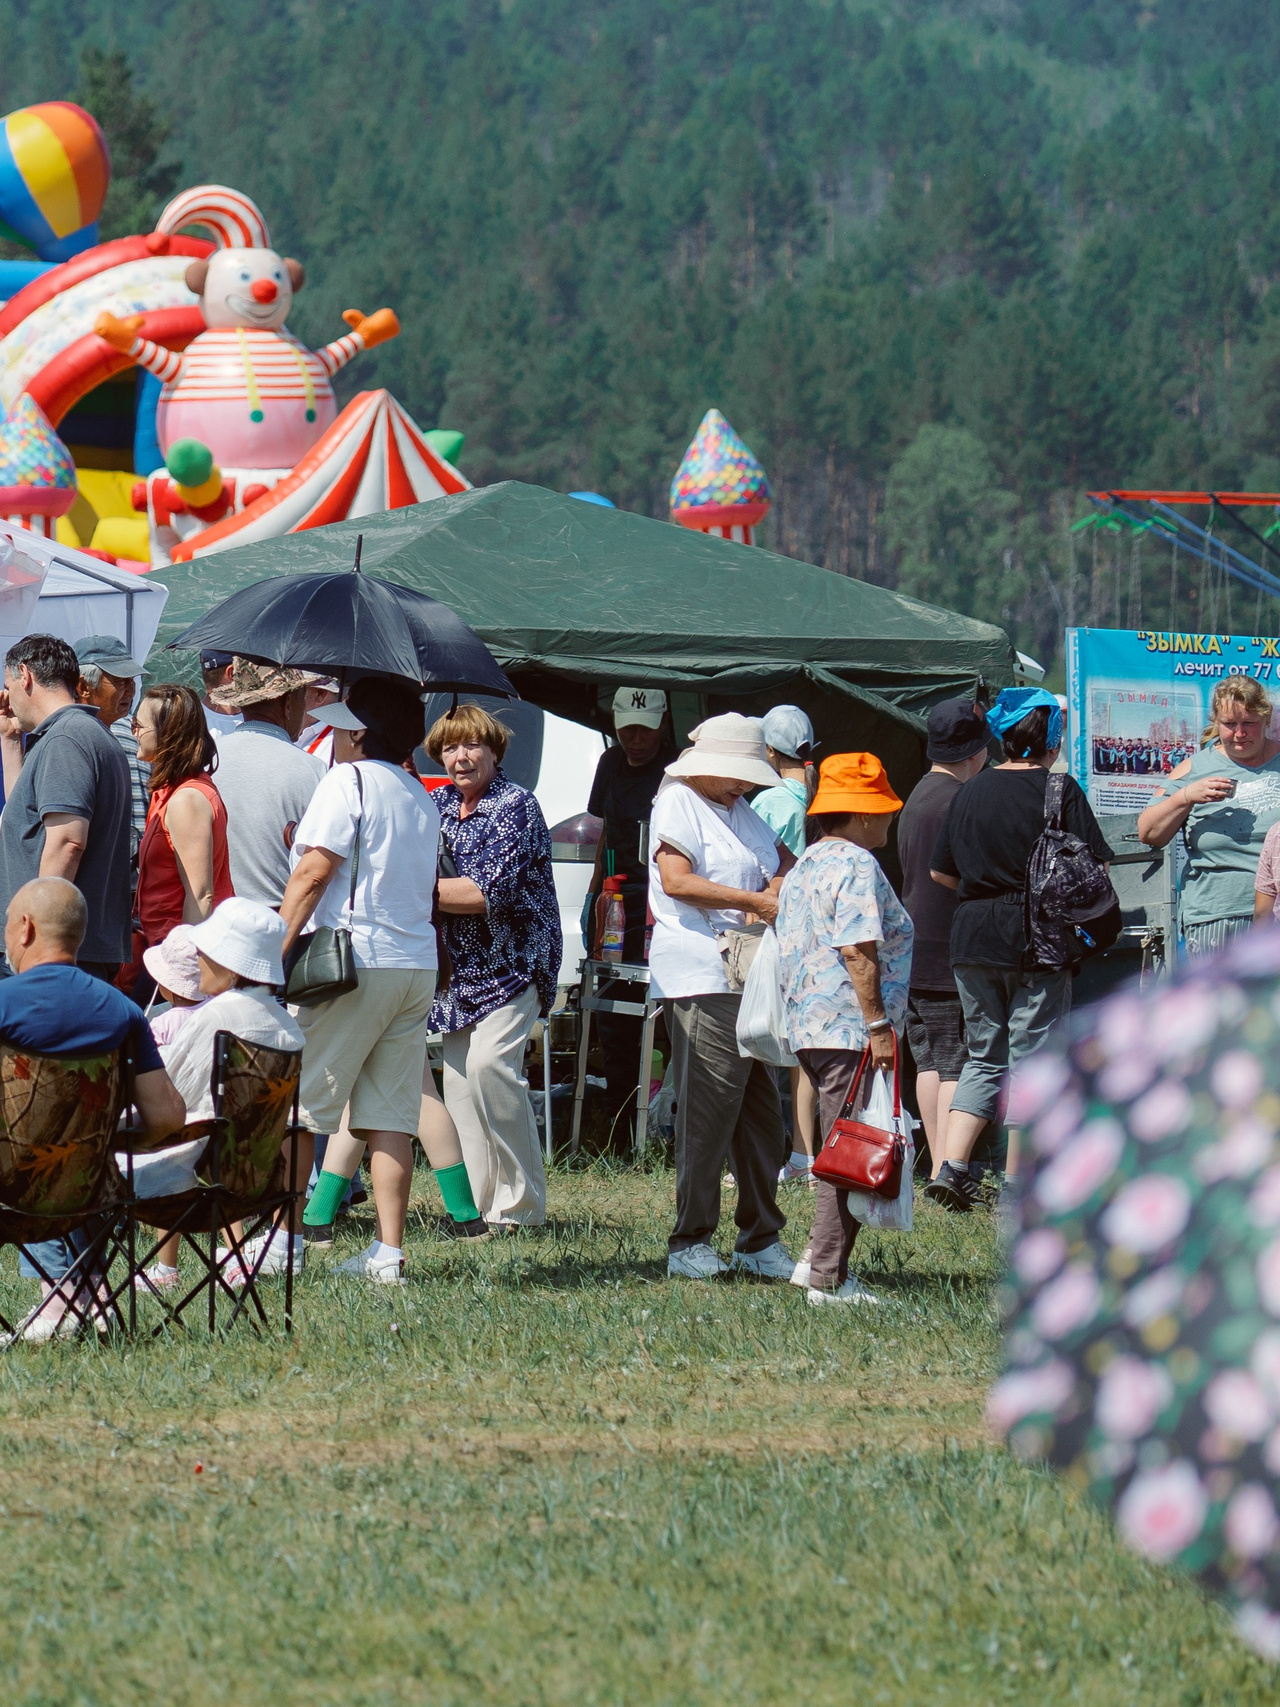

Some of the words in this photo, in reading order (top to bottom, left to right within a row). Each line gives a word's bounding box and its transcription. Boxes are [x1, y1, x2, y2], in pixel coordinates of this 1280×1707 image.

[1174, 661, 1225, 678] лечит
[1228, 664, 1250, 676] от
[1253, 662, 1273, 680] 77
[631, 690, 647, 709] NY
[1117, 692, 1168, 708] ЗЫМКА
